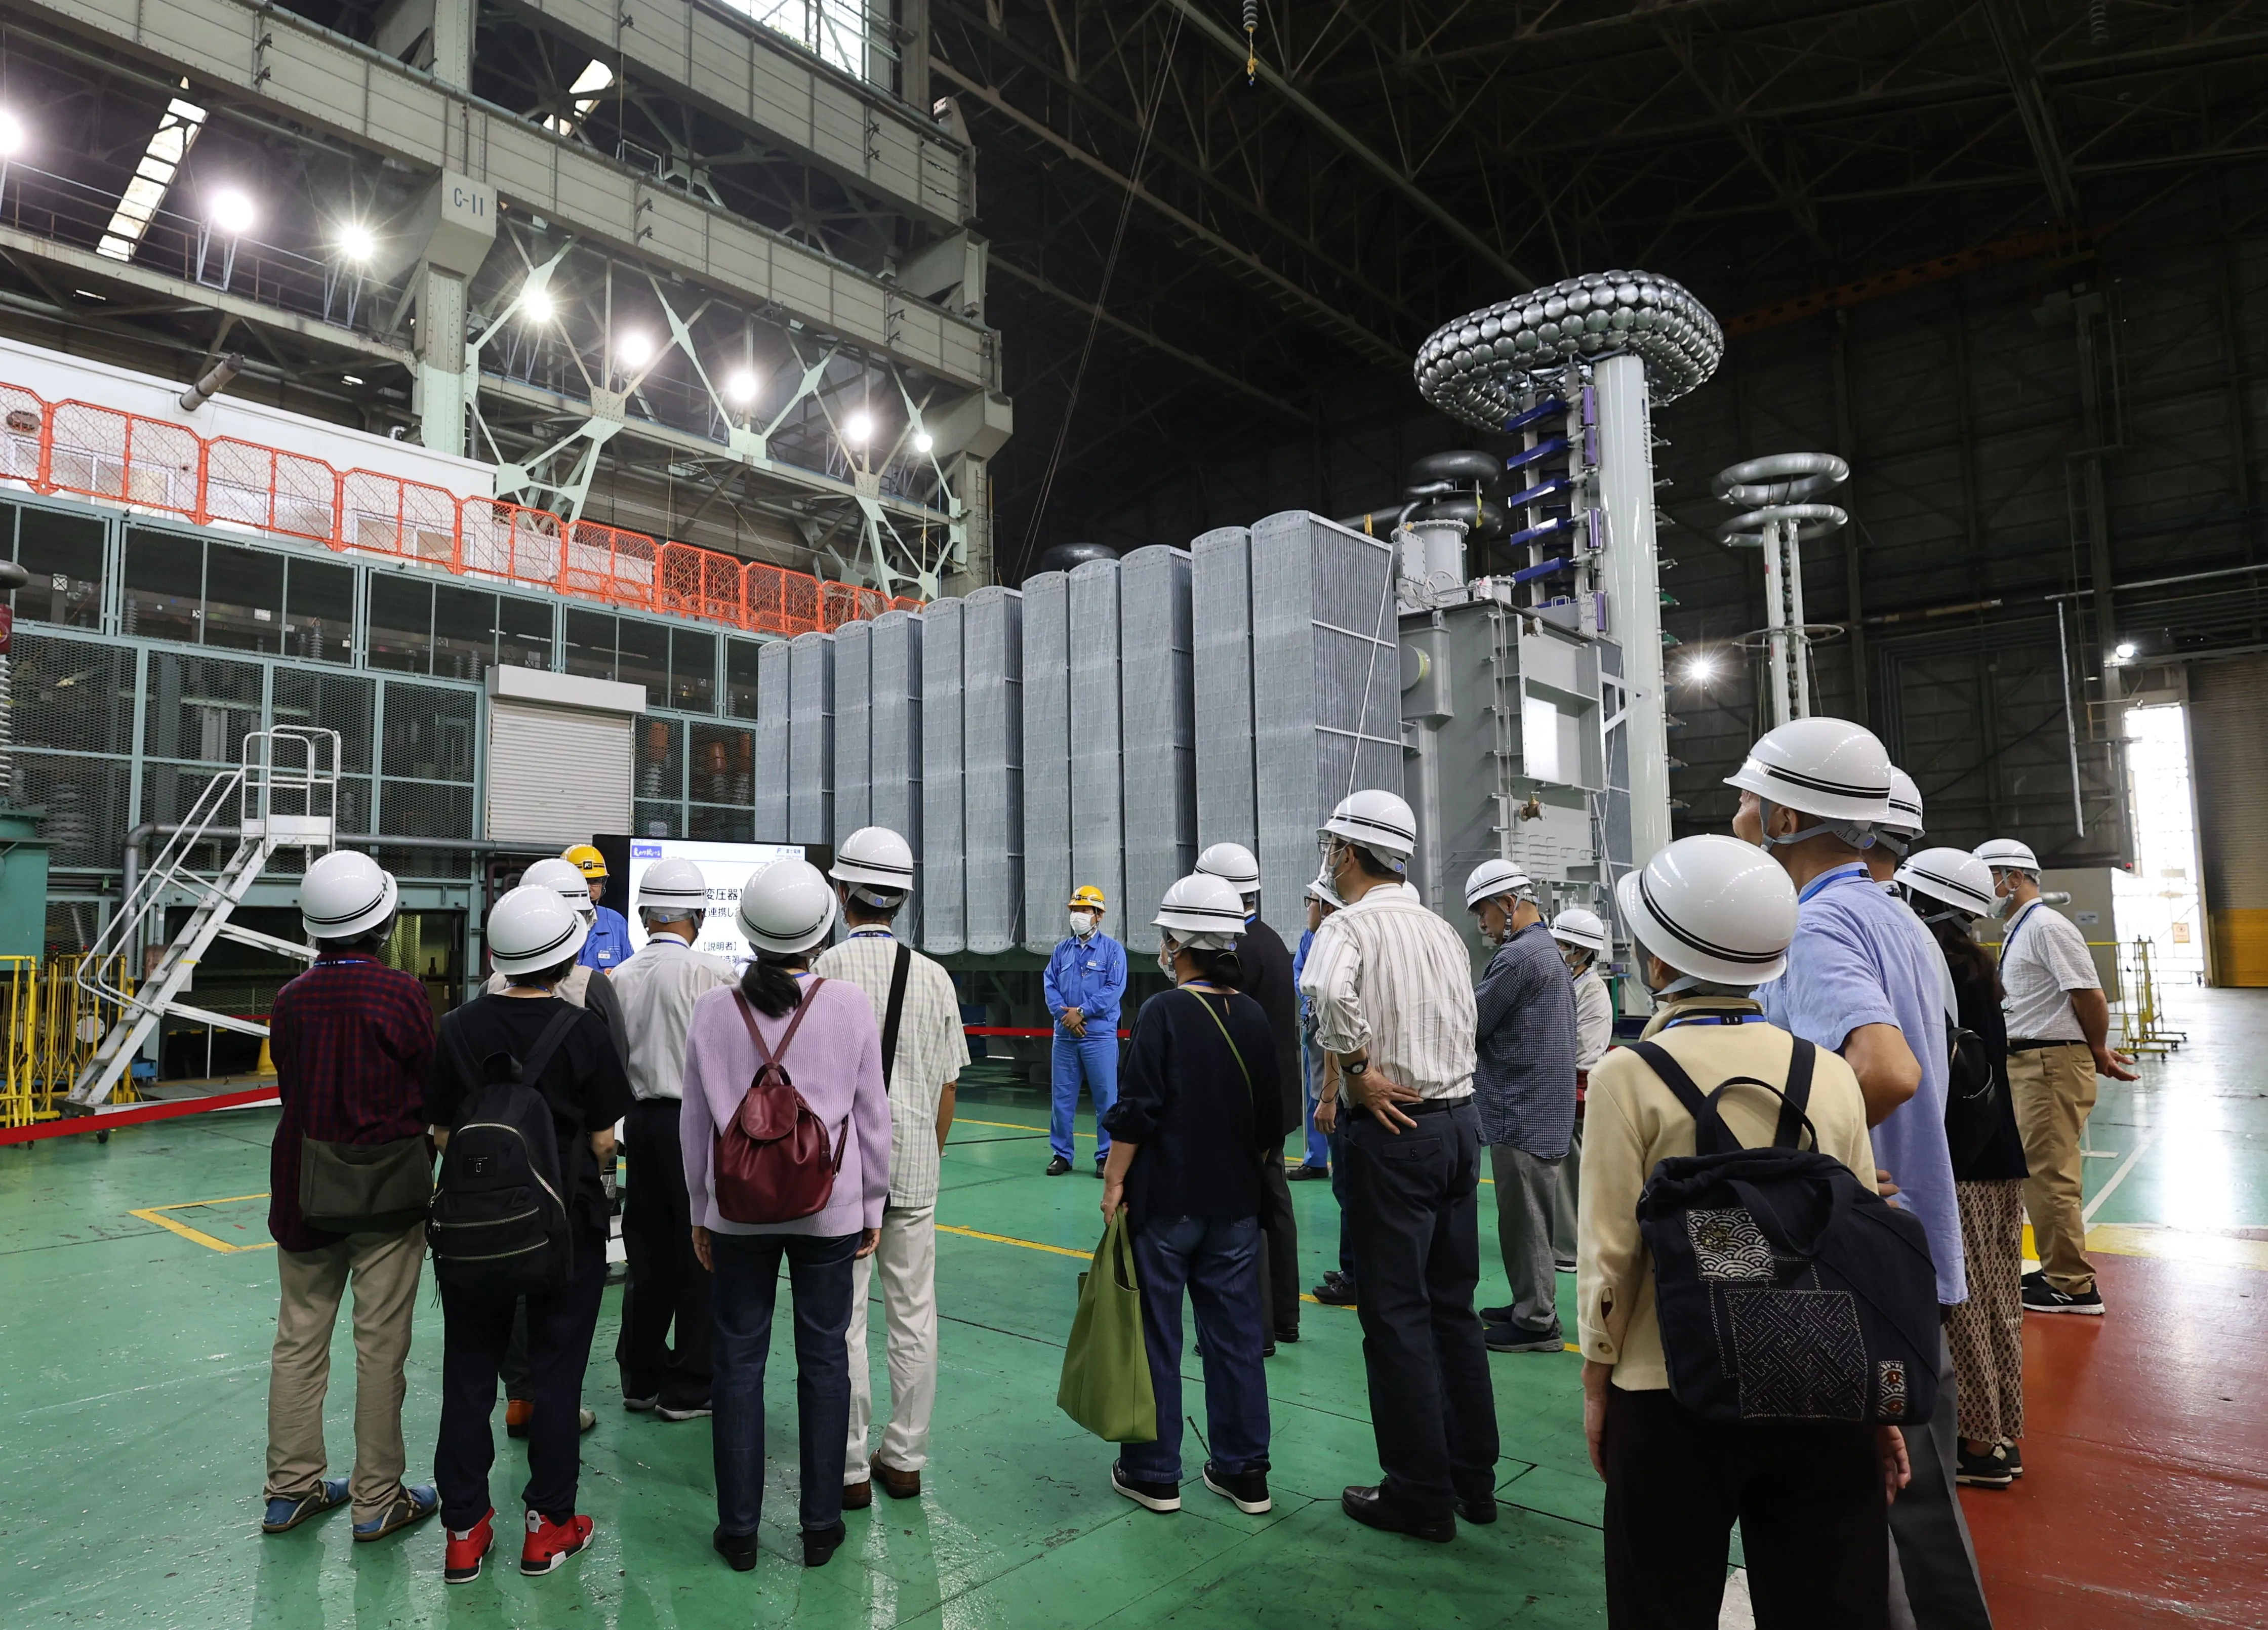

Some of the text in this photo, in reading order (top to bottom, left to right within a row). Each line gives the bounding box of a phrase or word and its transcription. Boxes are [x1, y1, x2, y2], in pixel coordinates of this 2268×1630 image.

[454, 188, 483, 216] C-11
[704, 907, 737, 917] 連携し
[704, 942, 737, 951] 【説明者】
